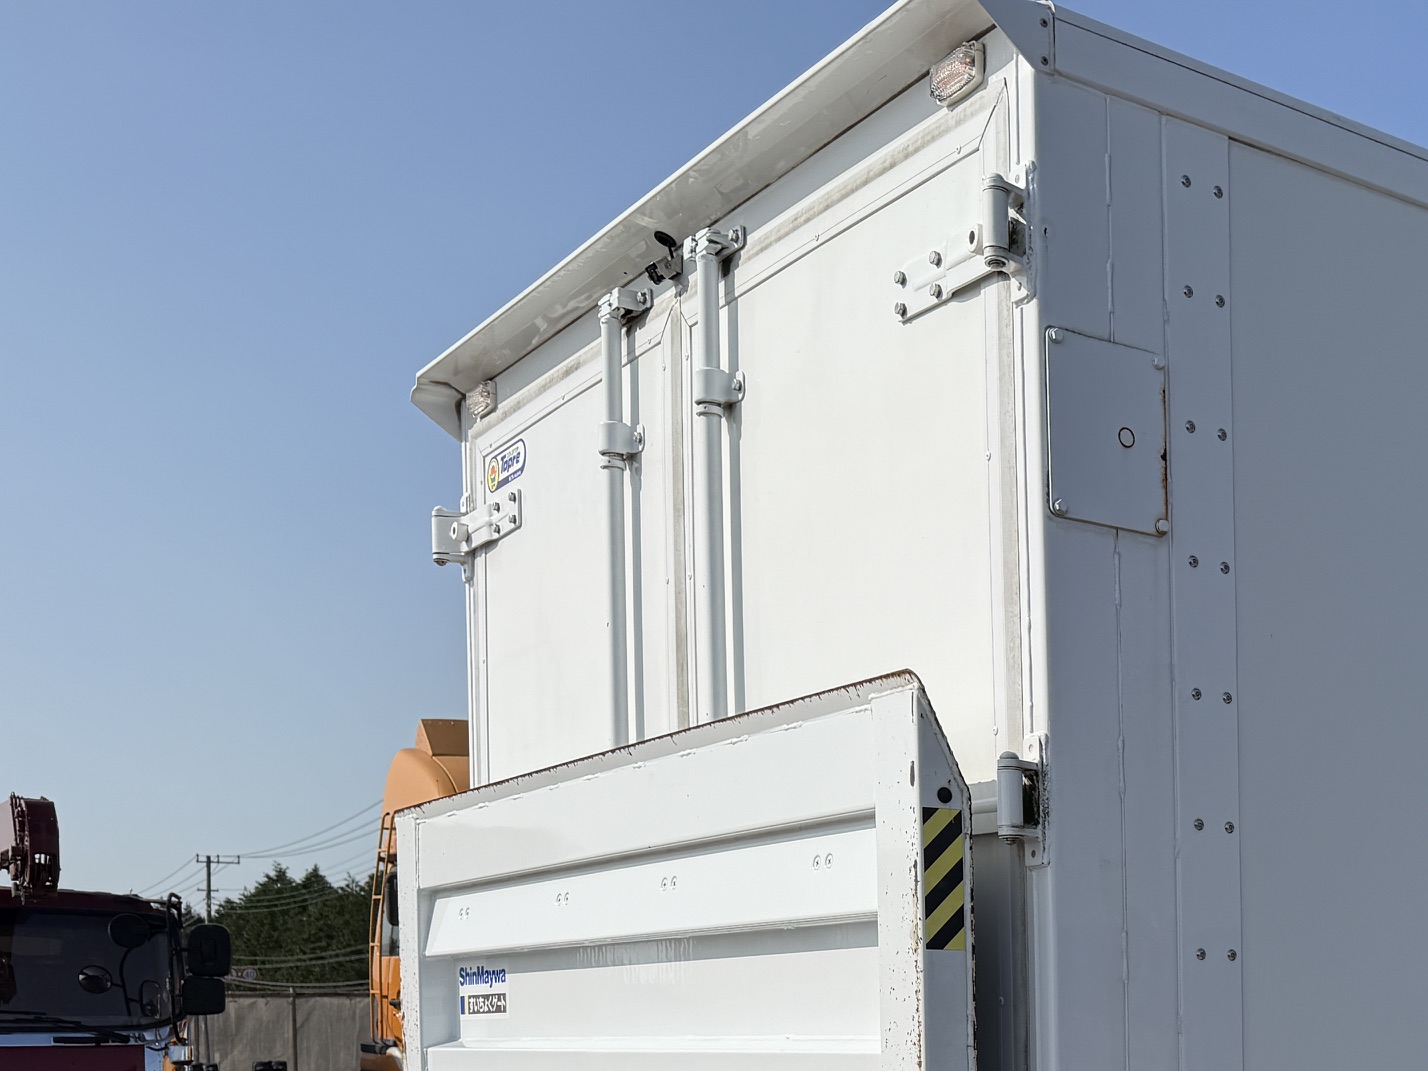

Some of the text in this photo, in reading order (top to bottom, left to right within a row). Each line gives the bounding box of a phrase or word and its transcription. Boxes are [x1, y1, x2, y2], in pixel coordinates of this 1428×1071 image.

[500, 452, 520, 474] Topre
[459, 965, 506, 988] ShinMaywa
[468, 995, 506, 1012] すいちょくゲート
